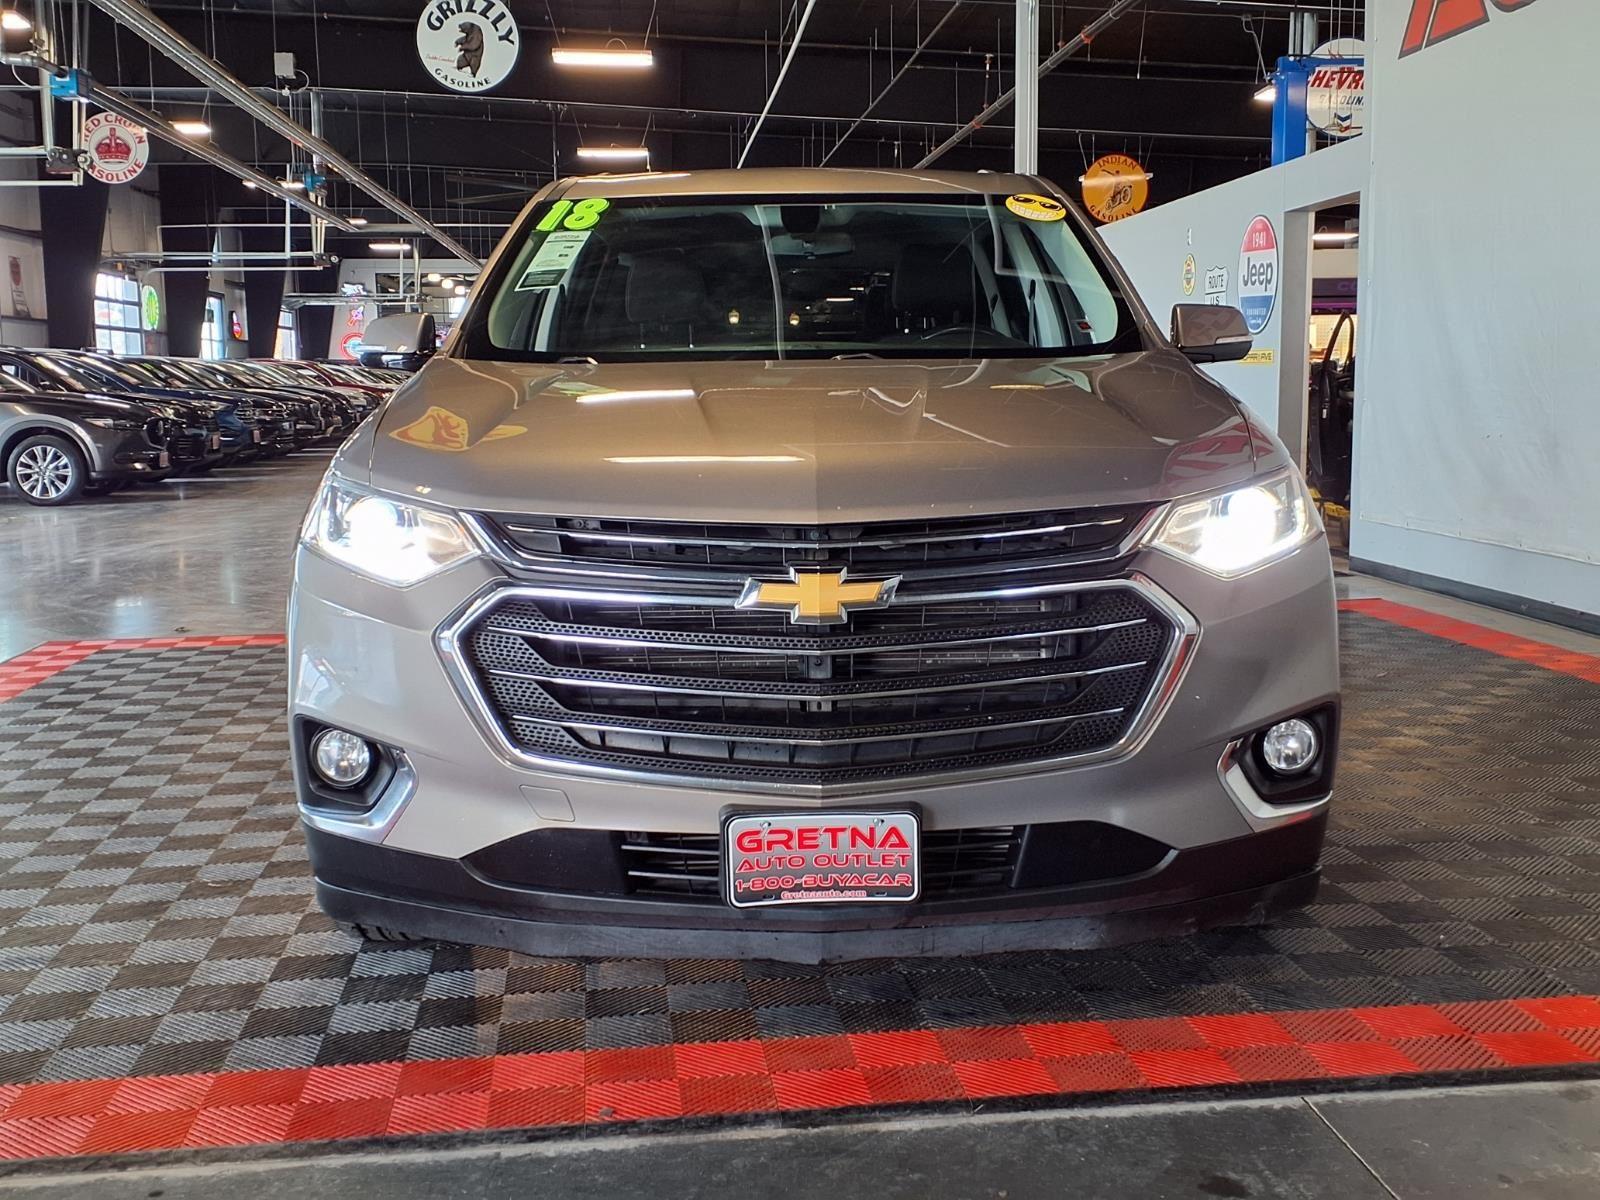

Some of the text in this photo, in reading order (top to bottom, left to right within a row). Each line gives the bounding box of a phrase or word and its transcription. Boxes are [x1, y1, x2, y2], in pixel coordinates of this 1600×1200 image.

[427, 0, 515, 46] GRIZZLY
[434, 67, 491, 88] GASOLINE
[1308, 69, 1364, 90] HEVR
[1319, 94, 1364, 106] GAOLIN
[104, 113, 146, 144] CRON
[88, 158, 145, 182] ASOLINE
[1097, 156, 1137, 170] INDIAN
[536, 198, 610, 231] 18
[1090, 204, 1137, 221] GASOLINE
[1252, 231, 1267, 248] 1941
[1208, 274, 1225, 289] ROUTE
[1242, 256, 1274, 292] Jeep
[735, 825, 910, 854] GRETNA
[735, 852, 912, 873] AUTO OUTLET
[735, 873, 912, 892] 1-800-BUYACAR
